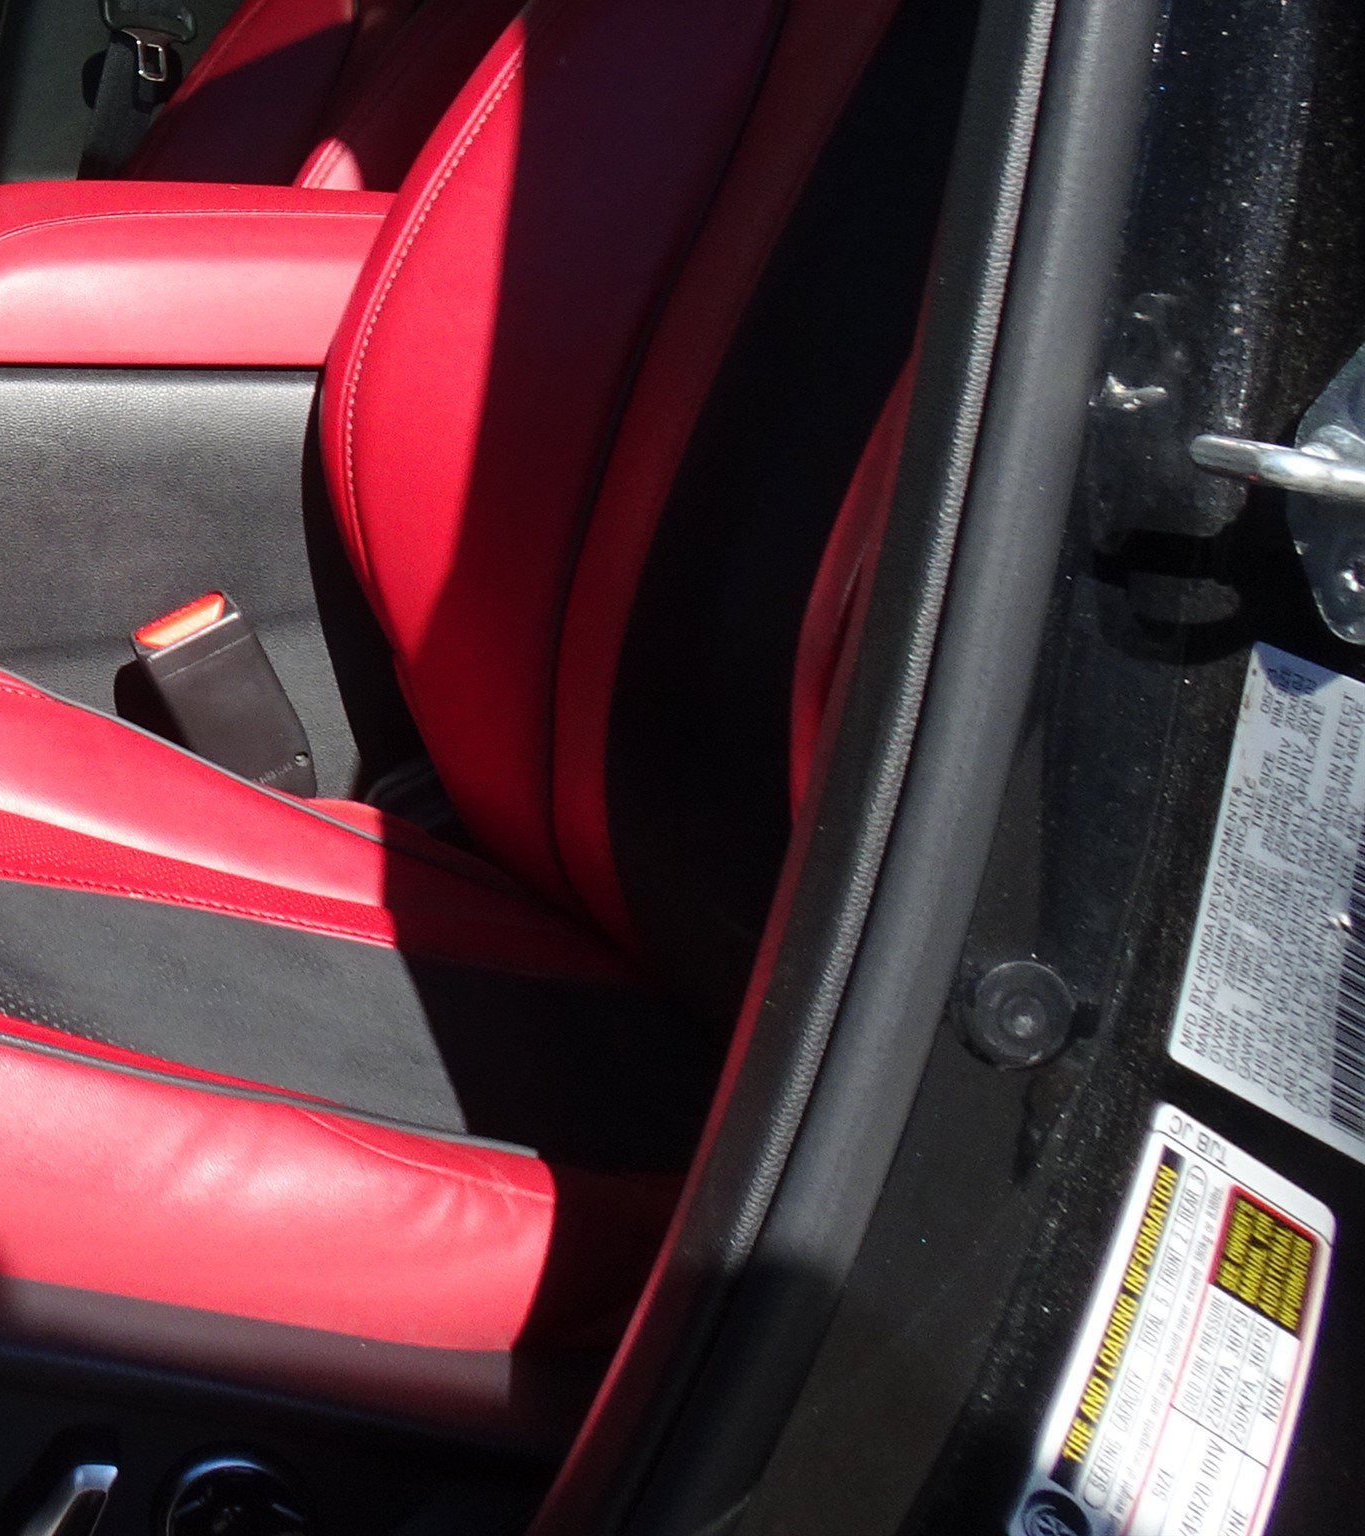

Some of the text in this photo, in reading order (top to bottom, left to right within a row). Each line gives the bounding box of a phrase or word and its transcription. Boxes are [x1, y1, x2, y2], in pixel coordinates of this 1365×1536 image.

[1193, 919, 1215, 982] HONDA
[1249, 1211, 1275, 1245] FOR
[1255, 1223, 1296, 1319] ADDITIONAL
[1062, 1162, 1180, 1467] TIRE AND LOADING INFORMATION
[1277, 1234, 1314, 1331] INFORMATION
[1107, 1367, 1146, 1433] CAPACITY
[1135, 1307, 1165, 1350] TOTAL
[1257, 1371, 1291, 1425] NONE
